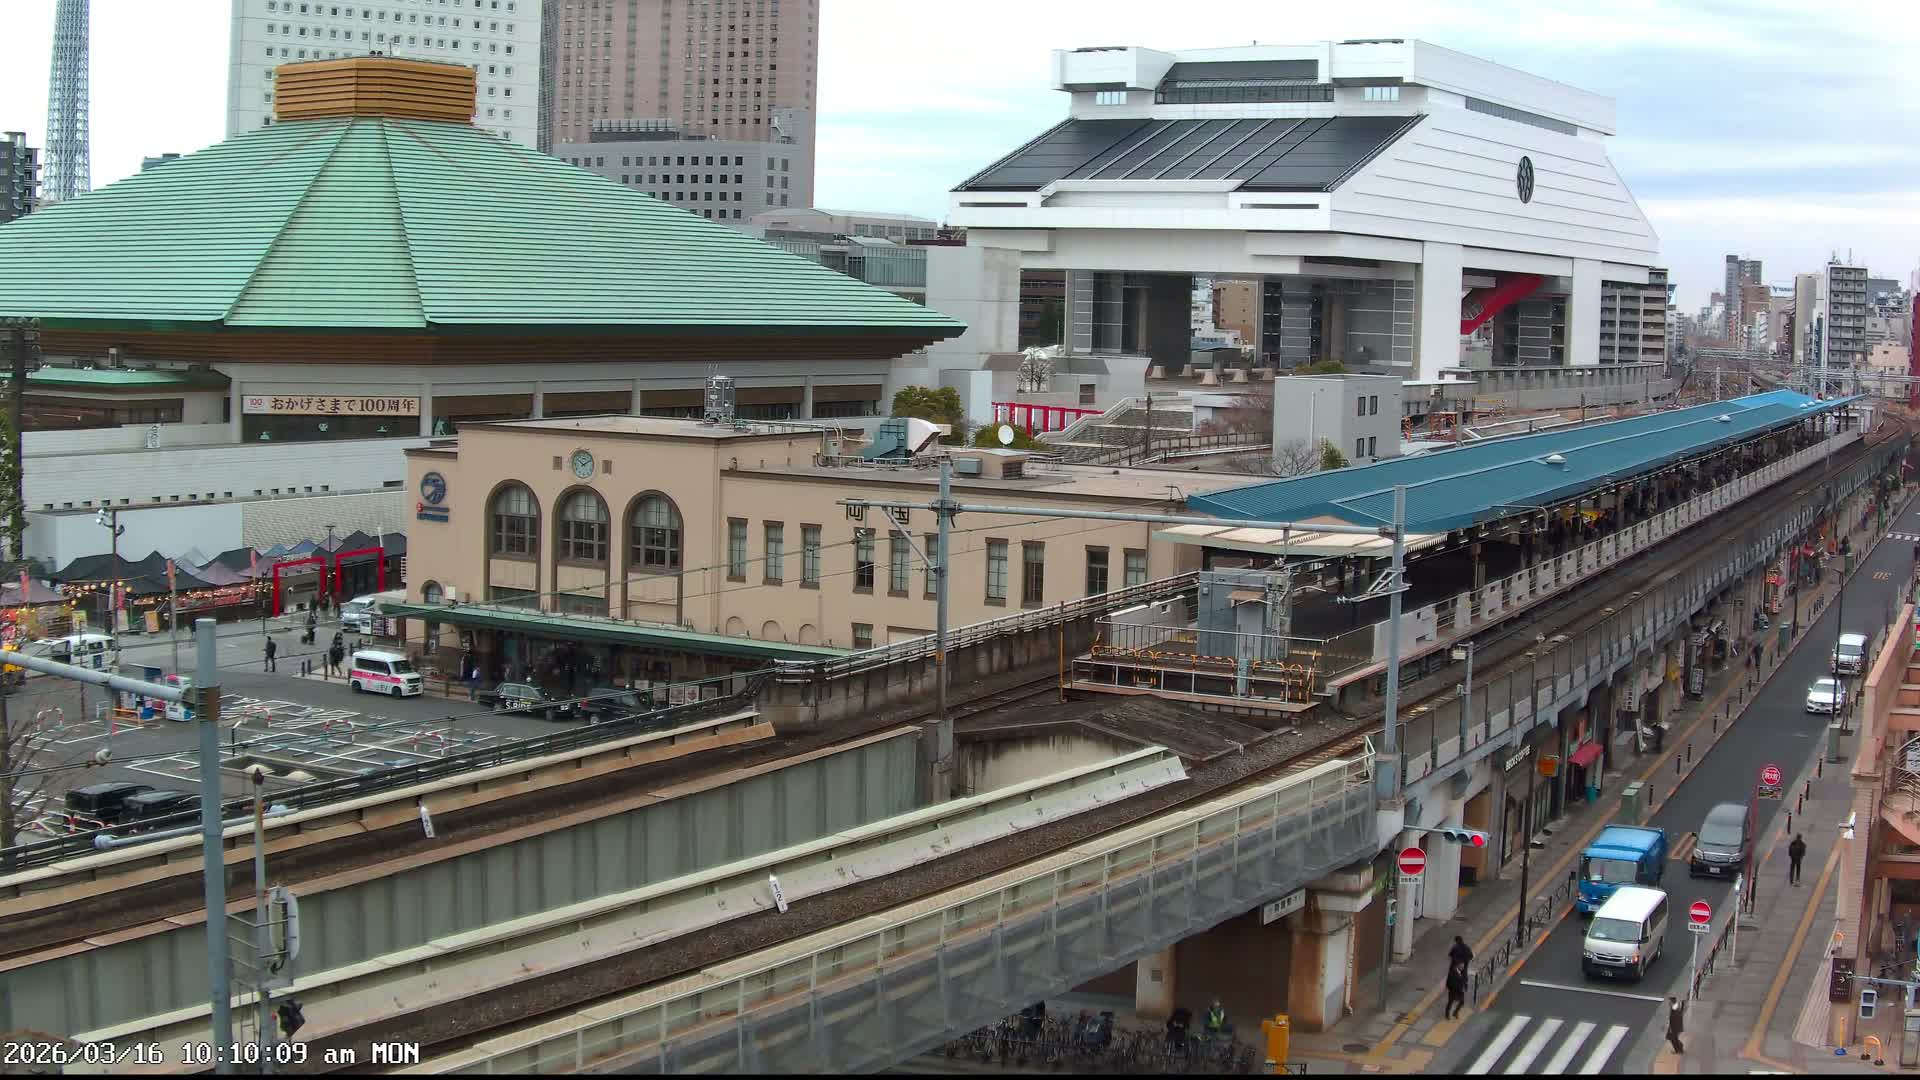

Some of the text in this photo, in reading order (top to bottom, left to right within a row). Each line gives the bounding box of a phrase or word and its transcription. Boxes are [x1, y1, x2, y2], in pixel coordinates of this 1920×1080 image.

[247, 398, 263, 406] 100
[271, 397, 414, 412] おかげさまで100周年
